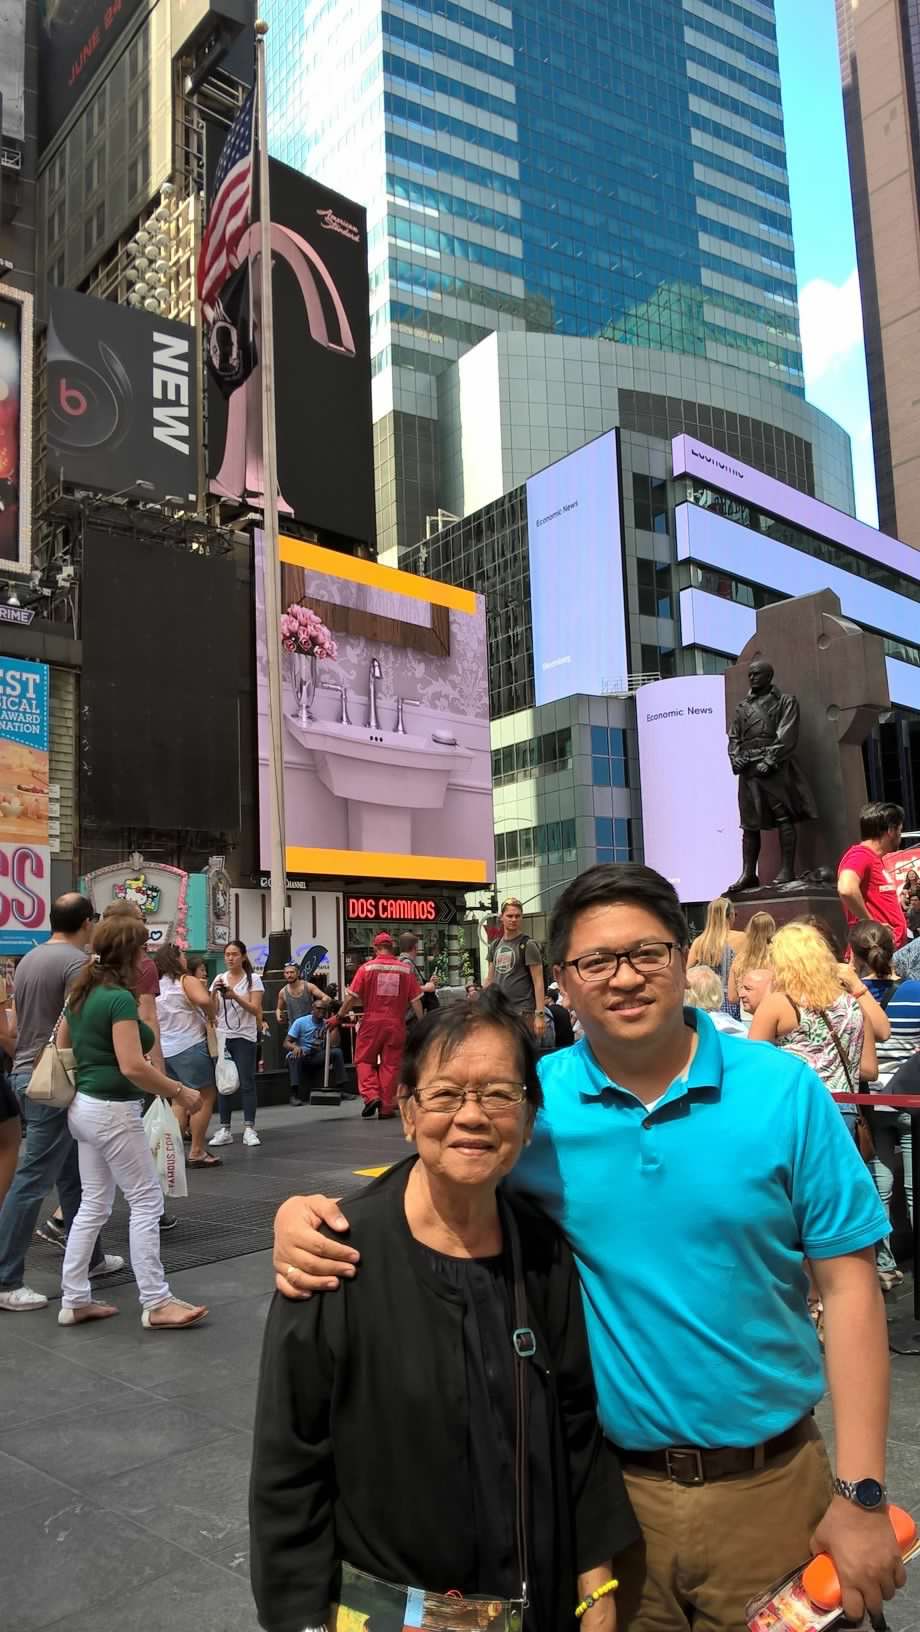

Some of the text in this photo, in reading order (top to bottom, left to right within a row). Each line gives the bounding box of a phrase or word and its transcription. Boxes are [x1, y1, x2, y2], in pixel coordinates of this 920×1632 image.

[153, 331, 190, 456] NEW
[0, 710, 41, 724] AWARD
[646, 706, 713, 722] Economic News
[349, 898, 436, 920] DOS CAMINOS
